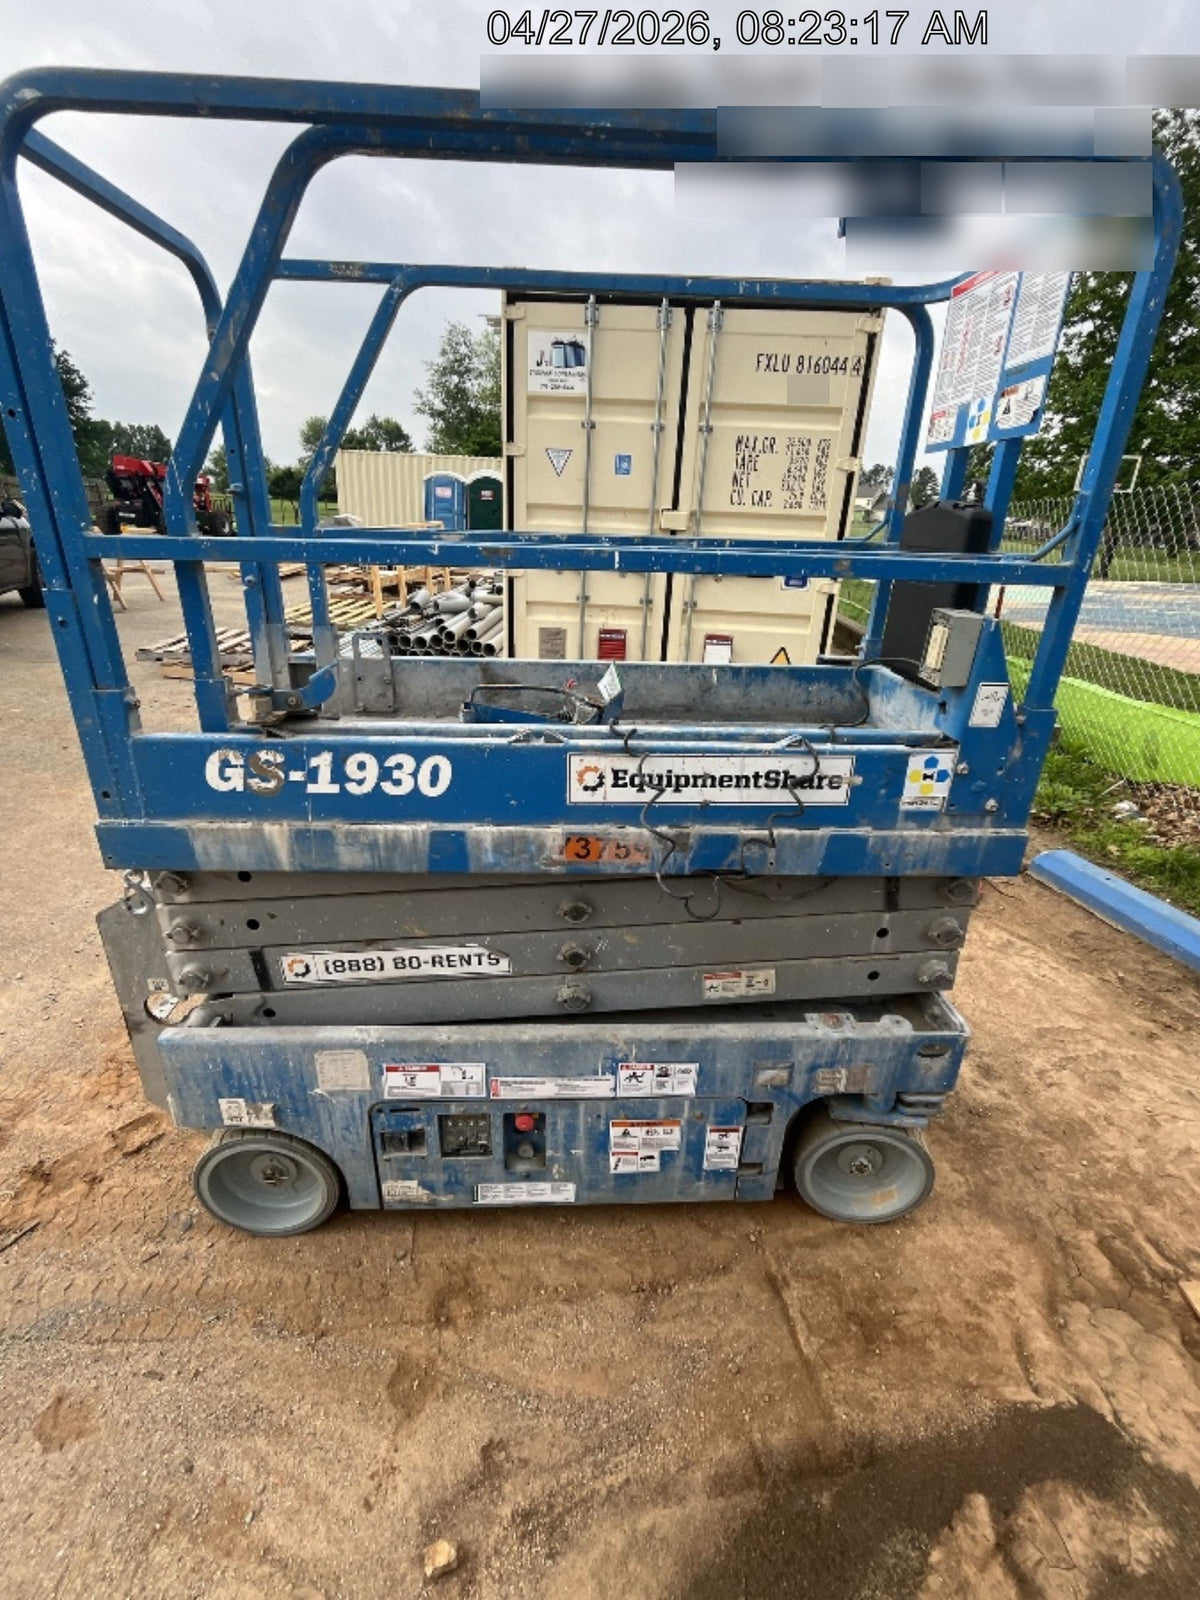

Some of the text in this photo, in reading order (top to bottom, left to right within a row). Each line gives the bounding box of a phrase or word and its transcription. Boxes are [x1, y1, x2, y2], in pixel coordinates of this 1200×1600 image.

[755, 353, 791, 373] FXLU
[796, 354, 849, 375] 816044
[731, 471, 751, 489] NET
[205, 749, 453, 798] GS-1930
[611, 768, 843, 793] EquipmentShare
[324, 956, 385, 975] (888)
